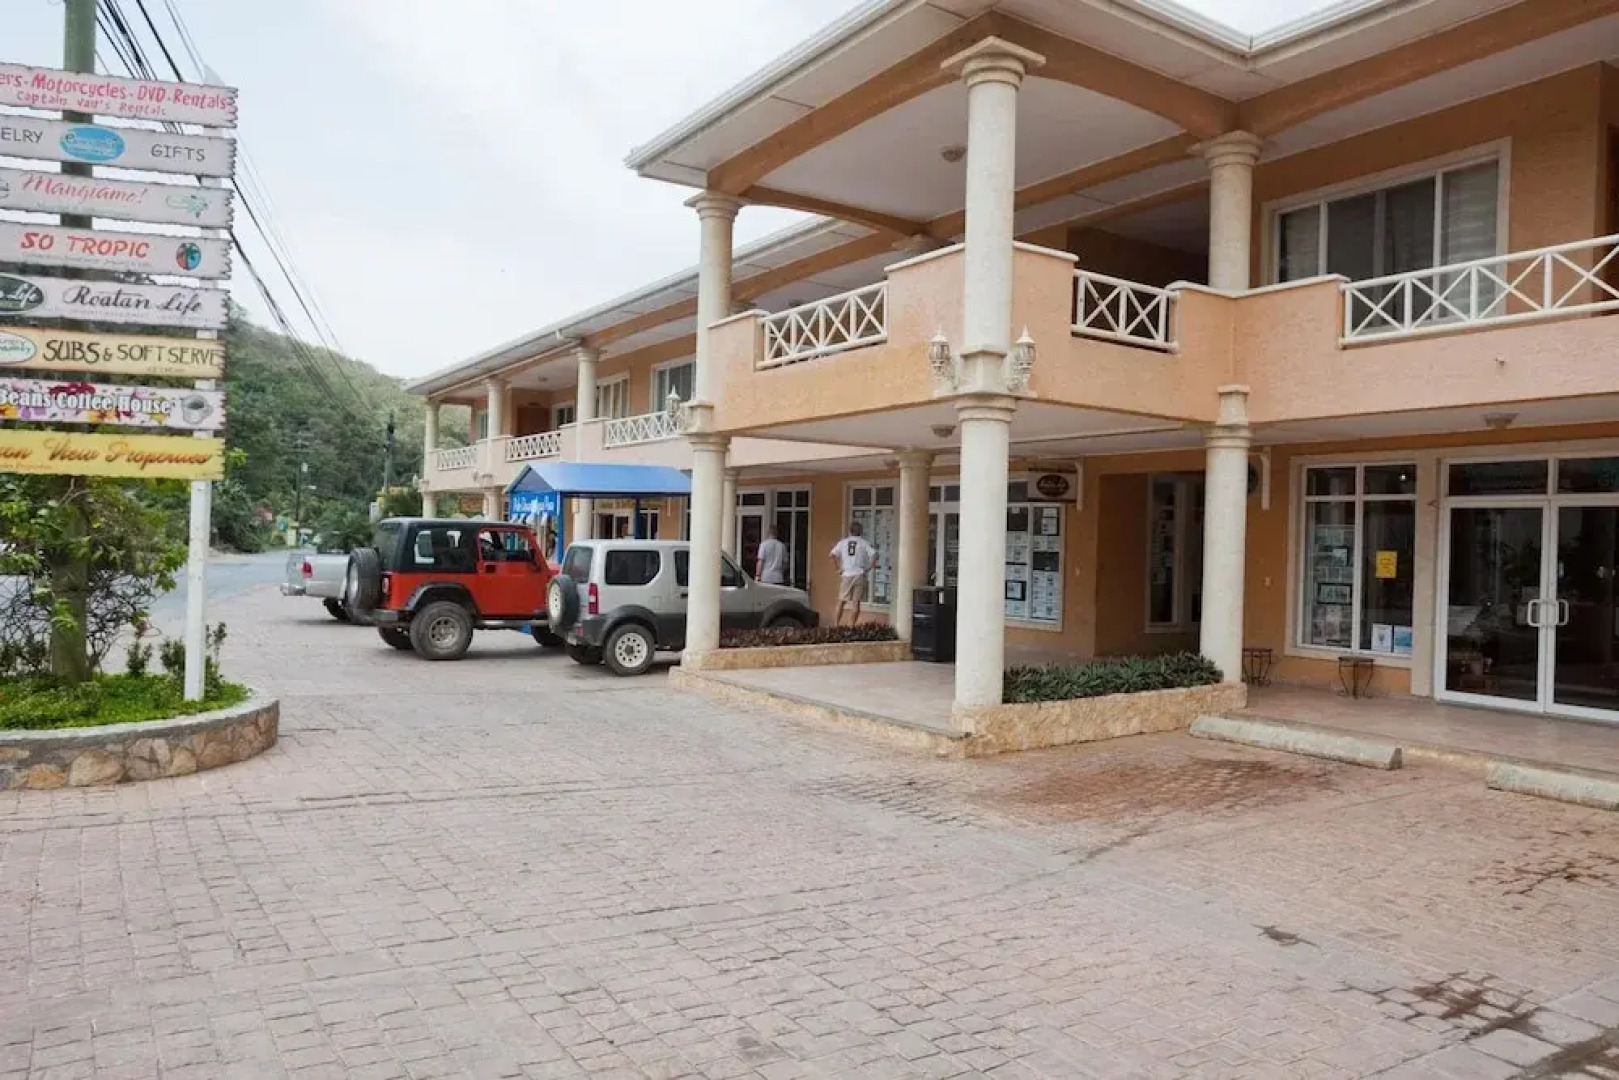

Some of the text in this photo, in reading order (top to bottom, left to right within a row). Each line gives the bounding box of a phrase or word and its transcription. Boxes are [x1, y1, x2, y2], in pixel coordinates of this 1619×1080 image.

[137, 85, 166, 102] DVD
[173, 89, 227, 109] Rentals
[151, 143, 206, 162] GIFTS
[20, 232, 149, 258] SO TROPIC
[62, 285, 150, 309] Roatan
[155, 292, 202, 315] Life
[43, 339, 101, 364] SUBS
[103, 347, 113, 361] &
[117, 344, 167, 361] SOFT
[168, 347, 220, 367] SERVE
[43, 438, 99, 461] View
